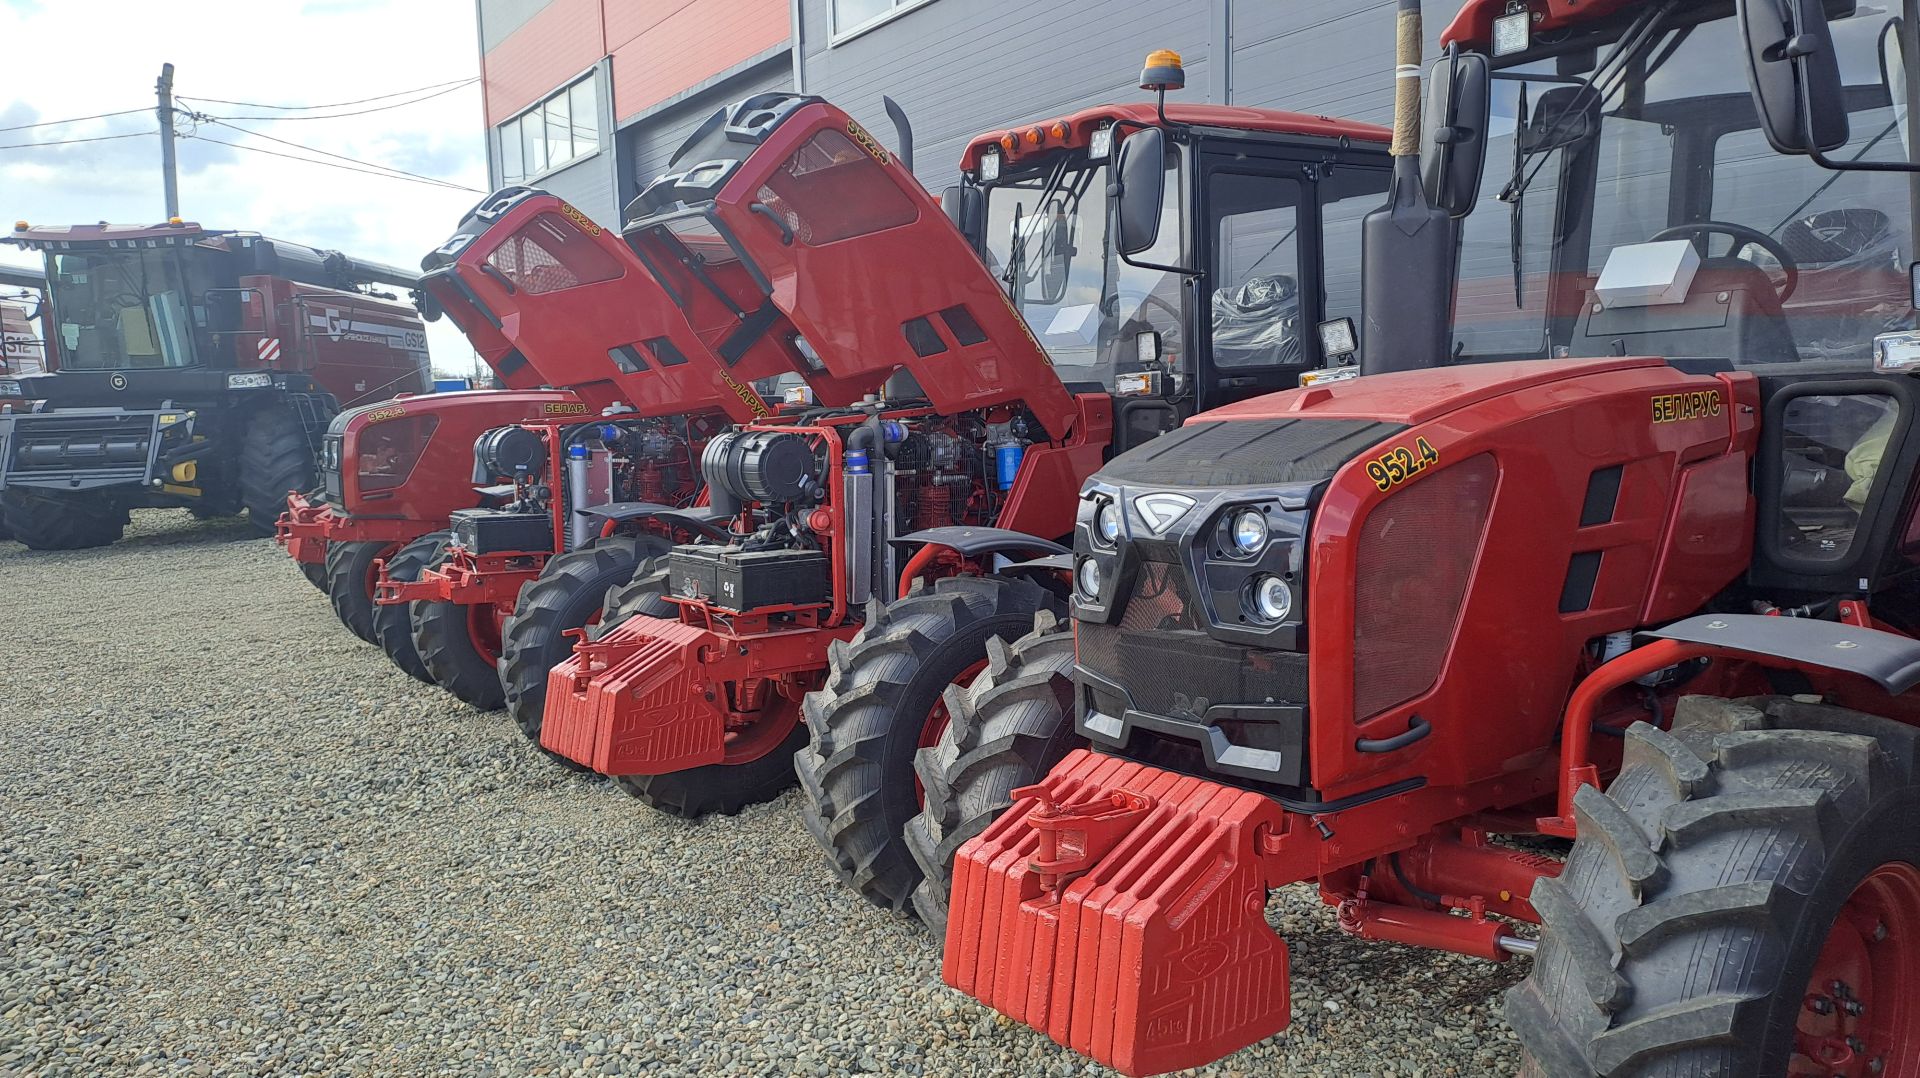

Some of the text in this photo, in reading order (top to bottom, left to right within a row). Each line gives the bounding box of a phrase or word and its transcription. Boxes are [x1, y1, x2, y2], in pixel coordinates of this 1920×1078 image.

[847, 119, 888, 166] 952.4
[562, 203, 601, 237] 952.3
[405, 332, 425, 348] GS12
[367, 406, 406, 423] 952.3
[1651, 389, 1721, 424] БЕЛАРУС
[1365, 435, 1440, 492] 952.4
